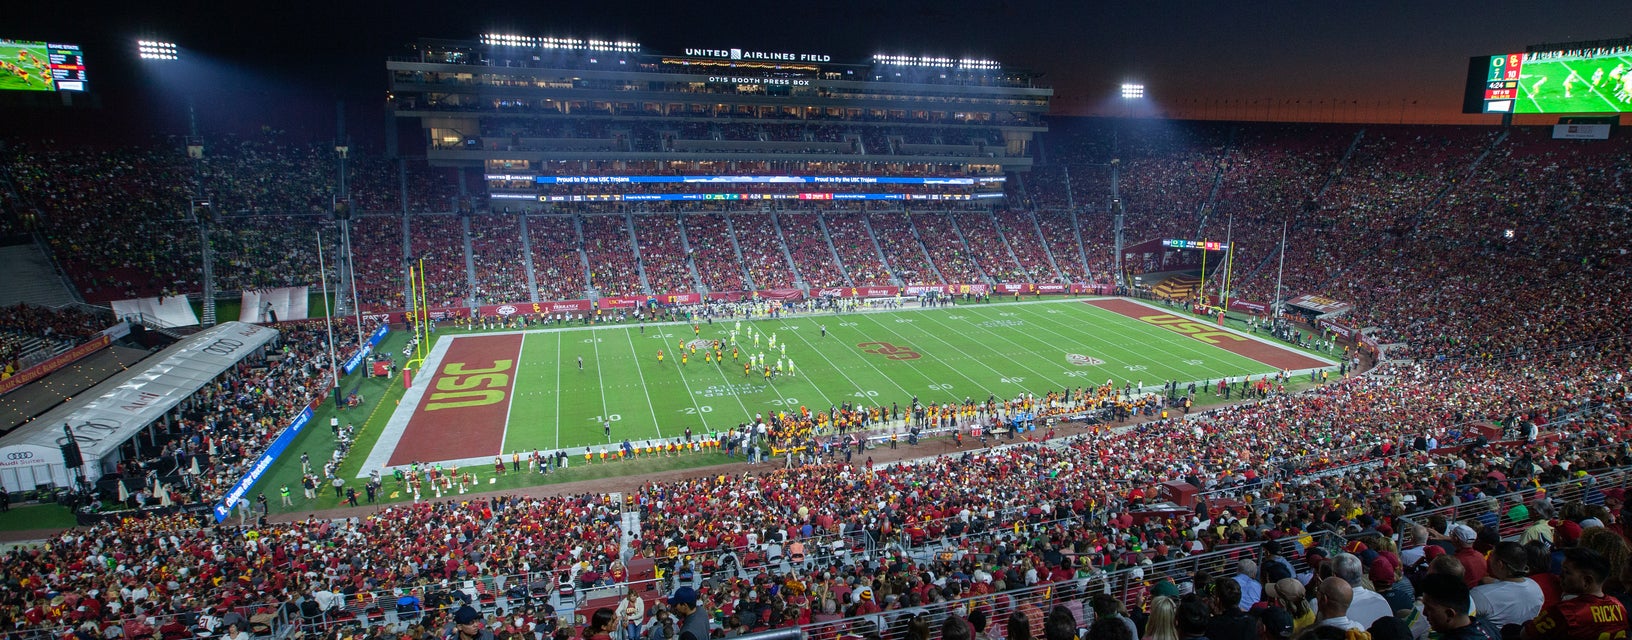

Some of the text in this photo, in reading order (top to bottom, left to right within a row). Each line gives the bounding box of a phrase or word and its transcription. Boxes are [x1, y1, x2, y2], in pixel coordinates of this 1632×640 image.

[685, 48, 831, 62] UNITED AIRLINES FIELD
[1139, 314, 1250, 344] USC
[424, 359, 512, 412] USC
[120, 392, 160, 412] Audi
[771, 398, 799, 406] 30
[683, 406, 713, 415] 20
[596, 414, 622, 423] 10
[242, 474, 254, 490] after
[1590, 605, 1623, 623] RICKY
[198, 618, 209, 630] 21
